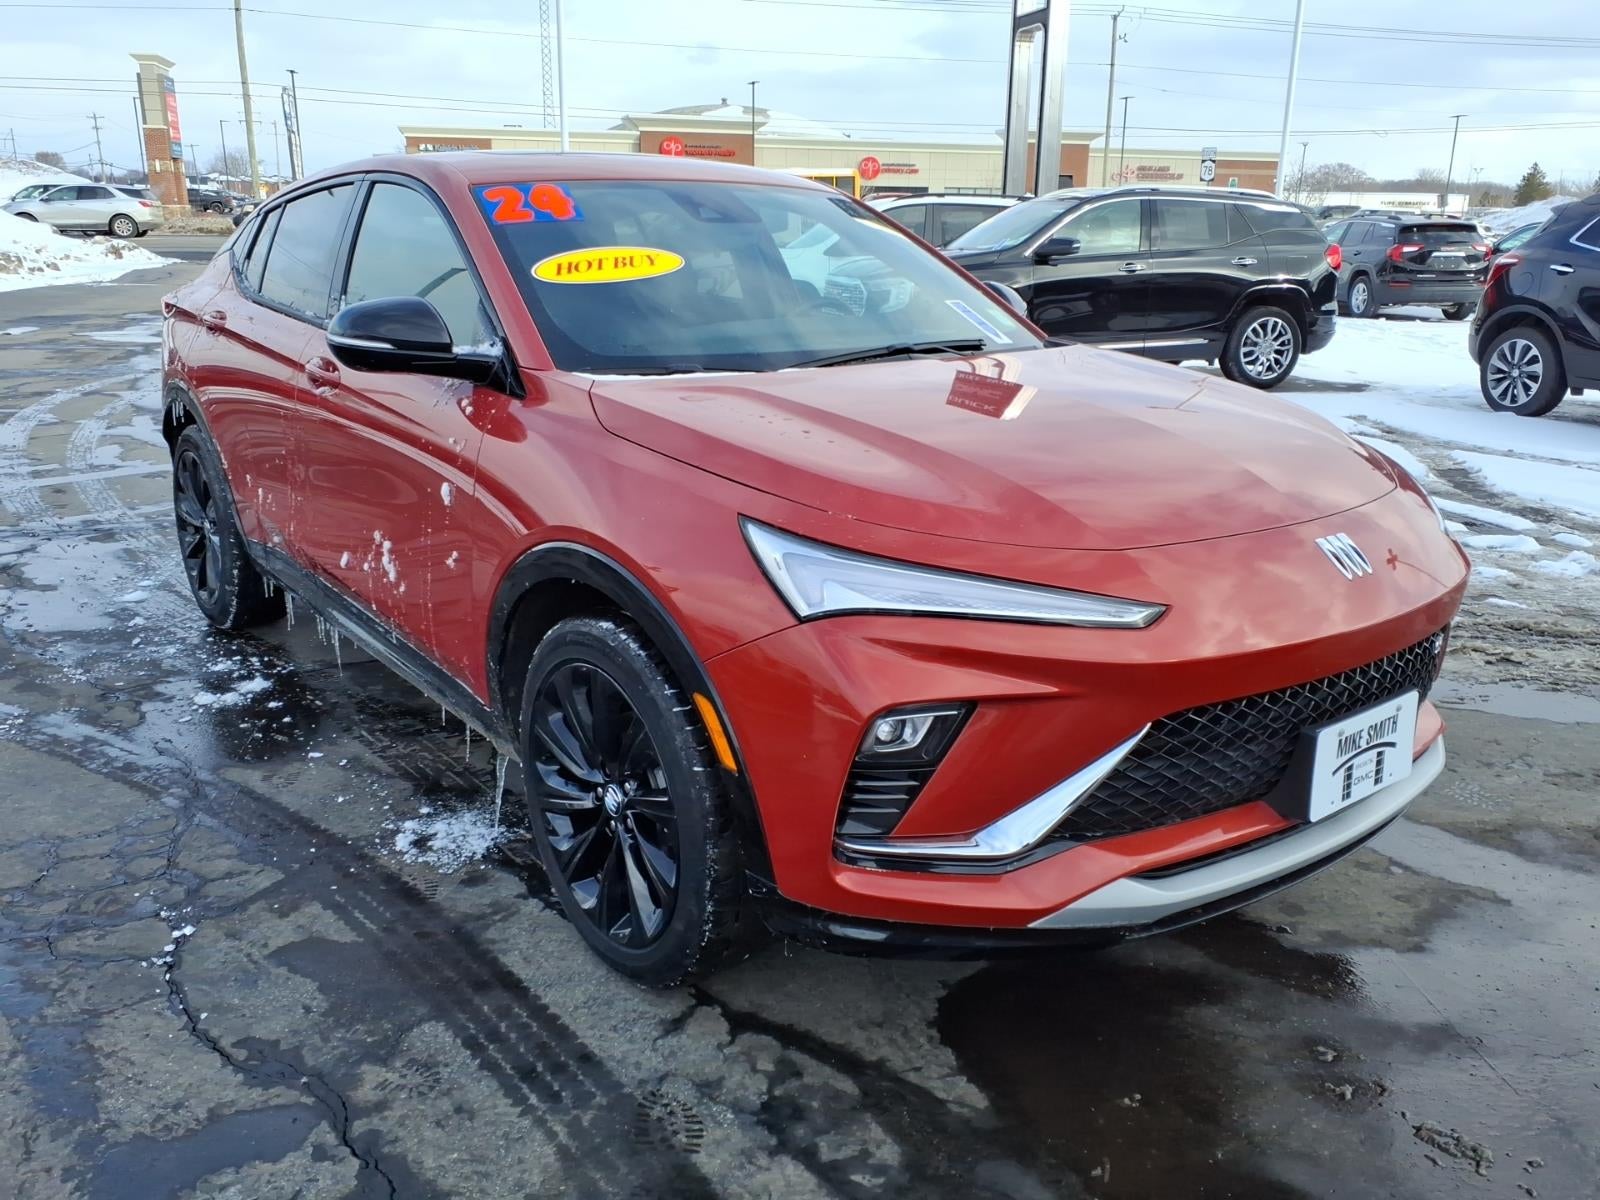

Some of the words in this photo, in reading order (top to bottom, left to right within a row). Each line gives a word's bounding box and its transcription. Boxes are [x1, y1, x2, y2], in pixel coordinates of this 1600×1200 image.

[1203, 165, 1213, 176] 78
[482, 183, 576, 223] 24
[556, 257, 609, 276] HOT
[614, 253, 660, 269] BUY
[1336, 729, 1364, 759] MIKE
[1366, 713, 1399, 745] SMITH
[1353, 769, 1374, 786] GMC
